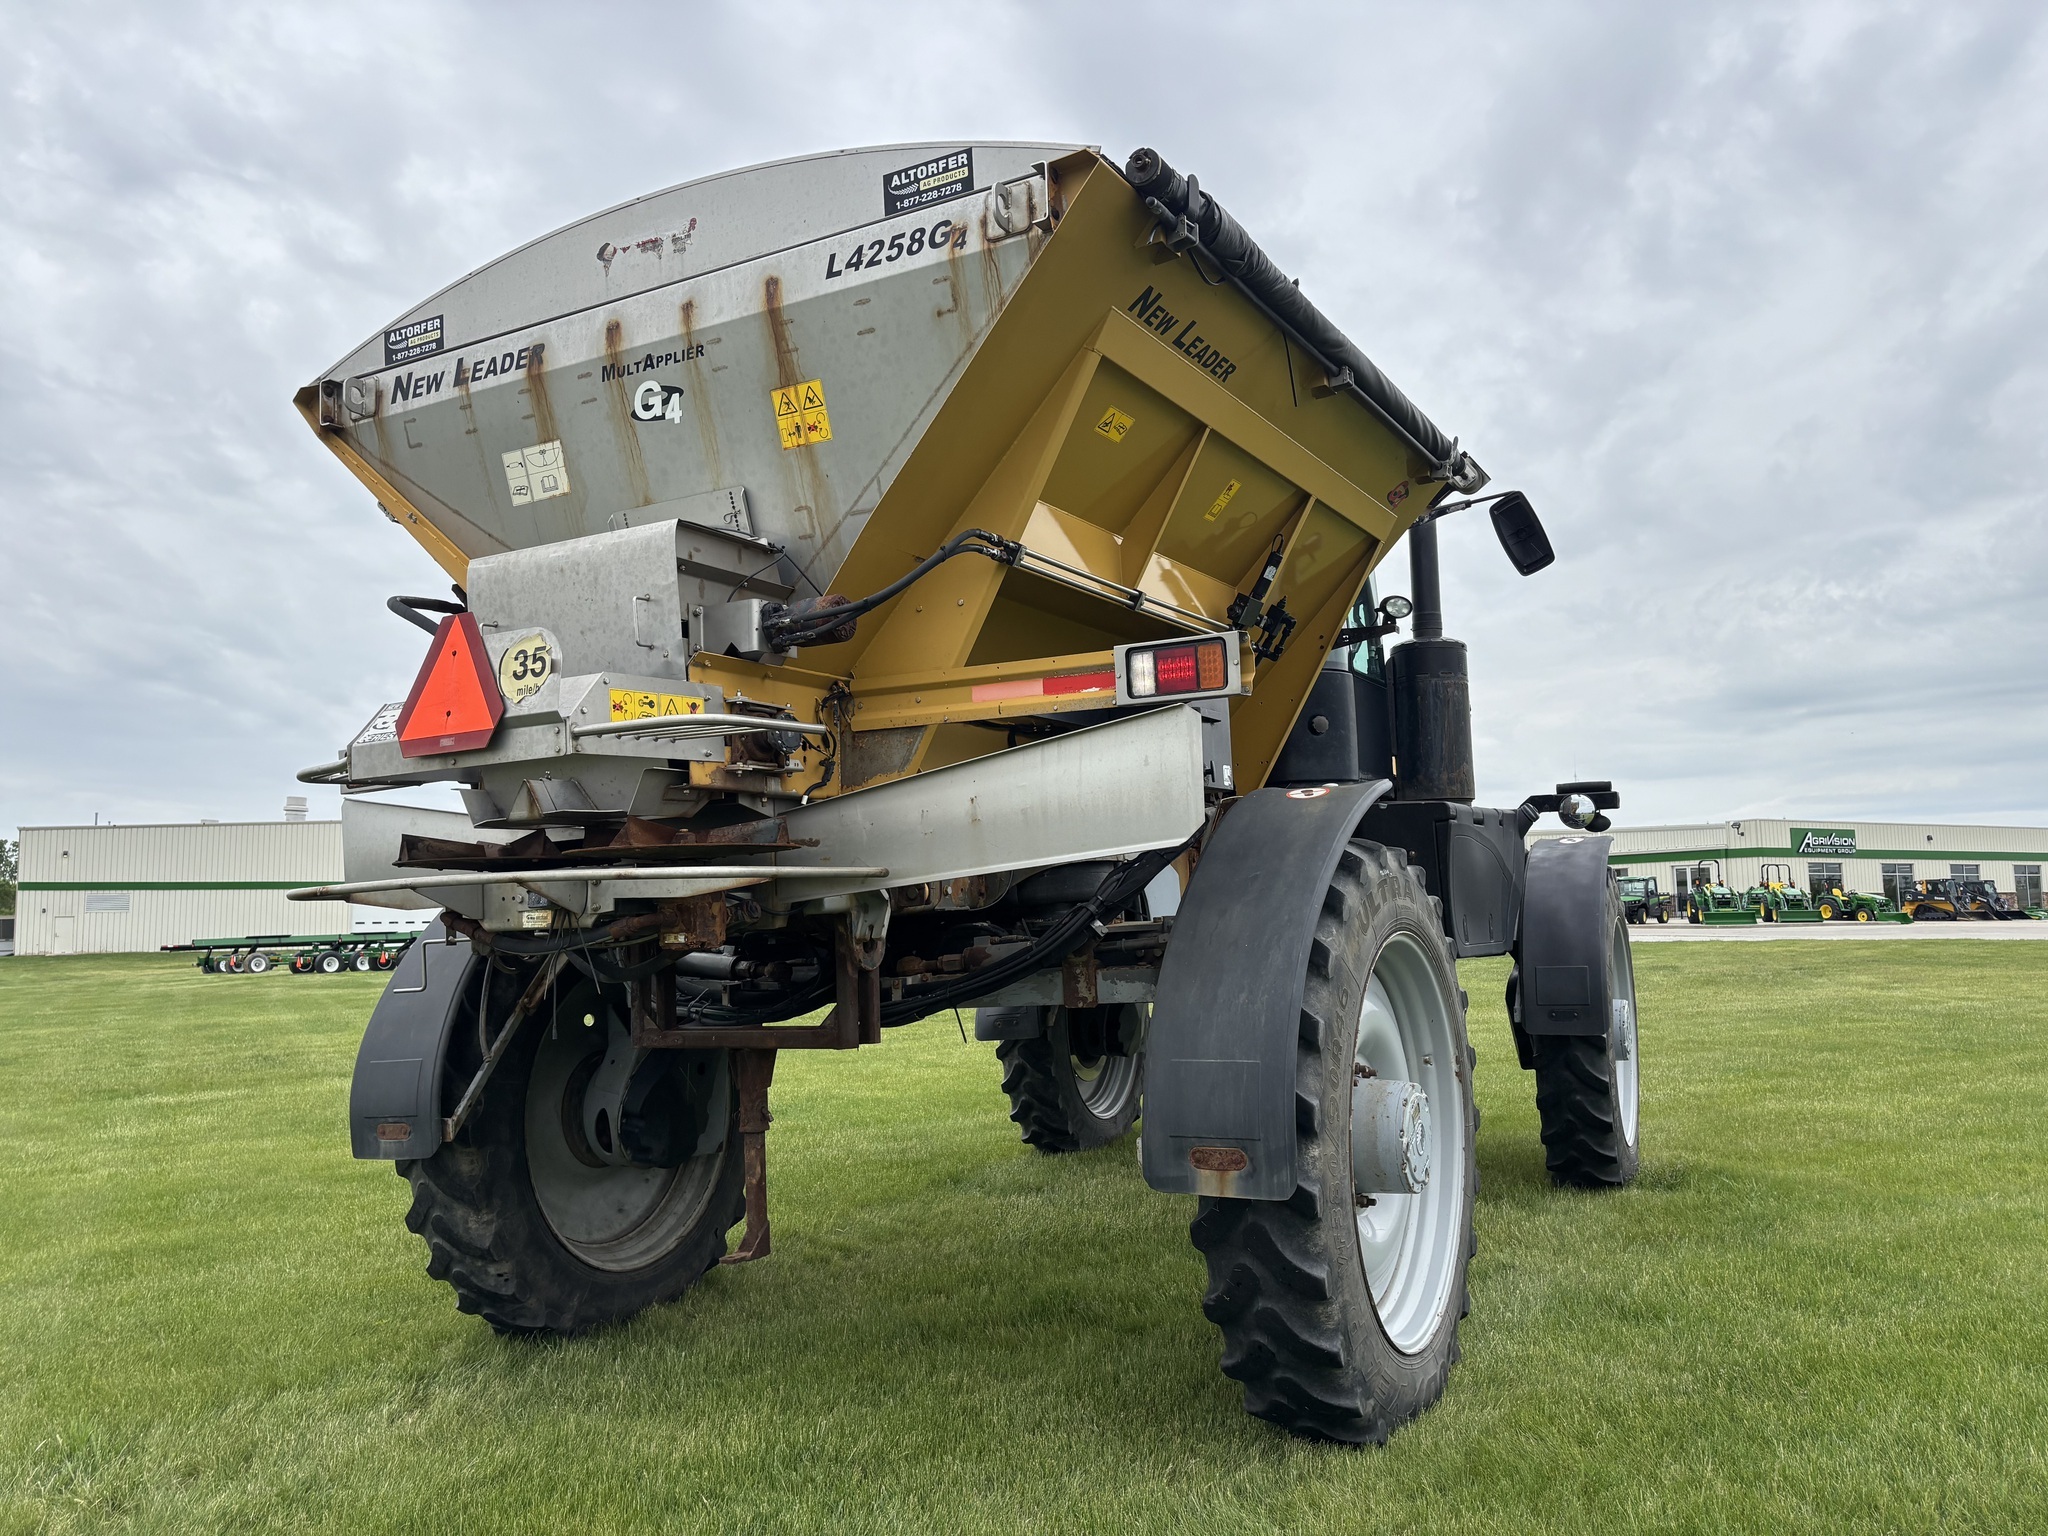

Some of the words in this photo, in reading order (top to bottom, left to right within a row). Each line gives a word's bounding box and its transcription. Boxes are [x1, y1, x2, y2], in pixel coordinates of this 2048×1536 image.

[890, 153, 968, 188] ALTORFER
[922, 180, 932, 188] AG
[932, 169, 966, 185] PRODUCTS
[895, 183, 962, 209] 1-877-228-7278
[825, 219, 967, 280] L4258G4
[389, 318, 441, 343] ALTORFER
[410, 338, 418, 347] AG
[418, 331, 440, 344] PRODUCTS
[392, 342, 437, 362] 1-877-228-7278
[634, 380, 683, 424] G4
[512, 645, 547, 681] 35
[1356, 873, 1418, 937] ULTRA
